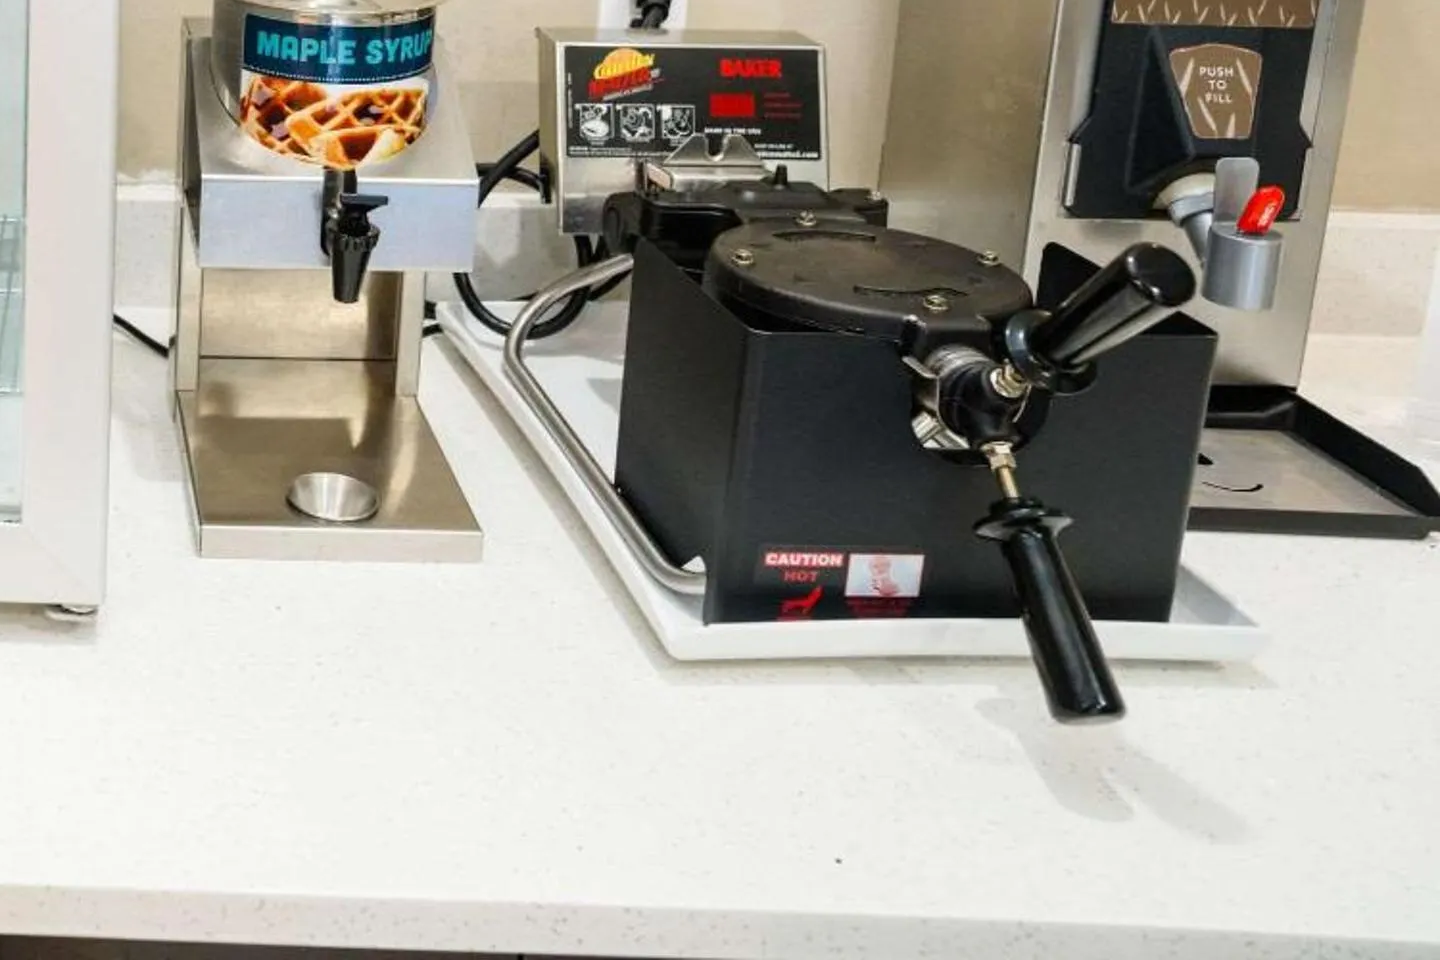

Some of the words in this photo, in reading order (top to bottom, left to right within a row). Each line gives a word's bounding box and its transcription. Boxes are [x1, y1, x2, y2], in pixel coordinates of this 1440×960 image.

[256, 30, 357, 65] MAPLE
[719, 58, 782, 78] BAKER
[1199, 66, 1234, 77] PUSH
[1208, 79, 1228, 90] TO
[1204, 93, 1233, 104] FILL
[765, 552, 843, 566] CAUTION
[783, 570, 819, 583] HOT
